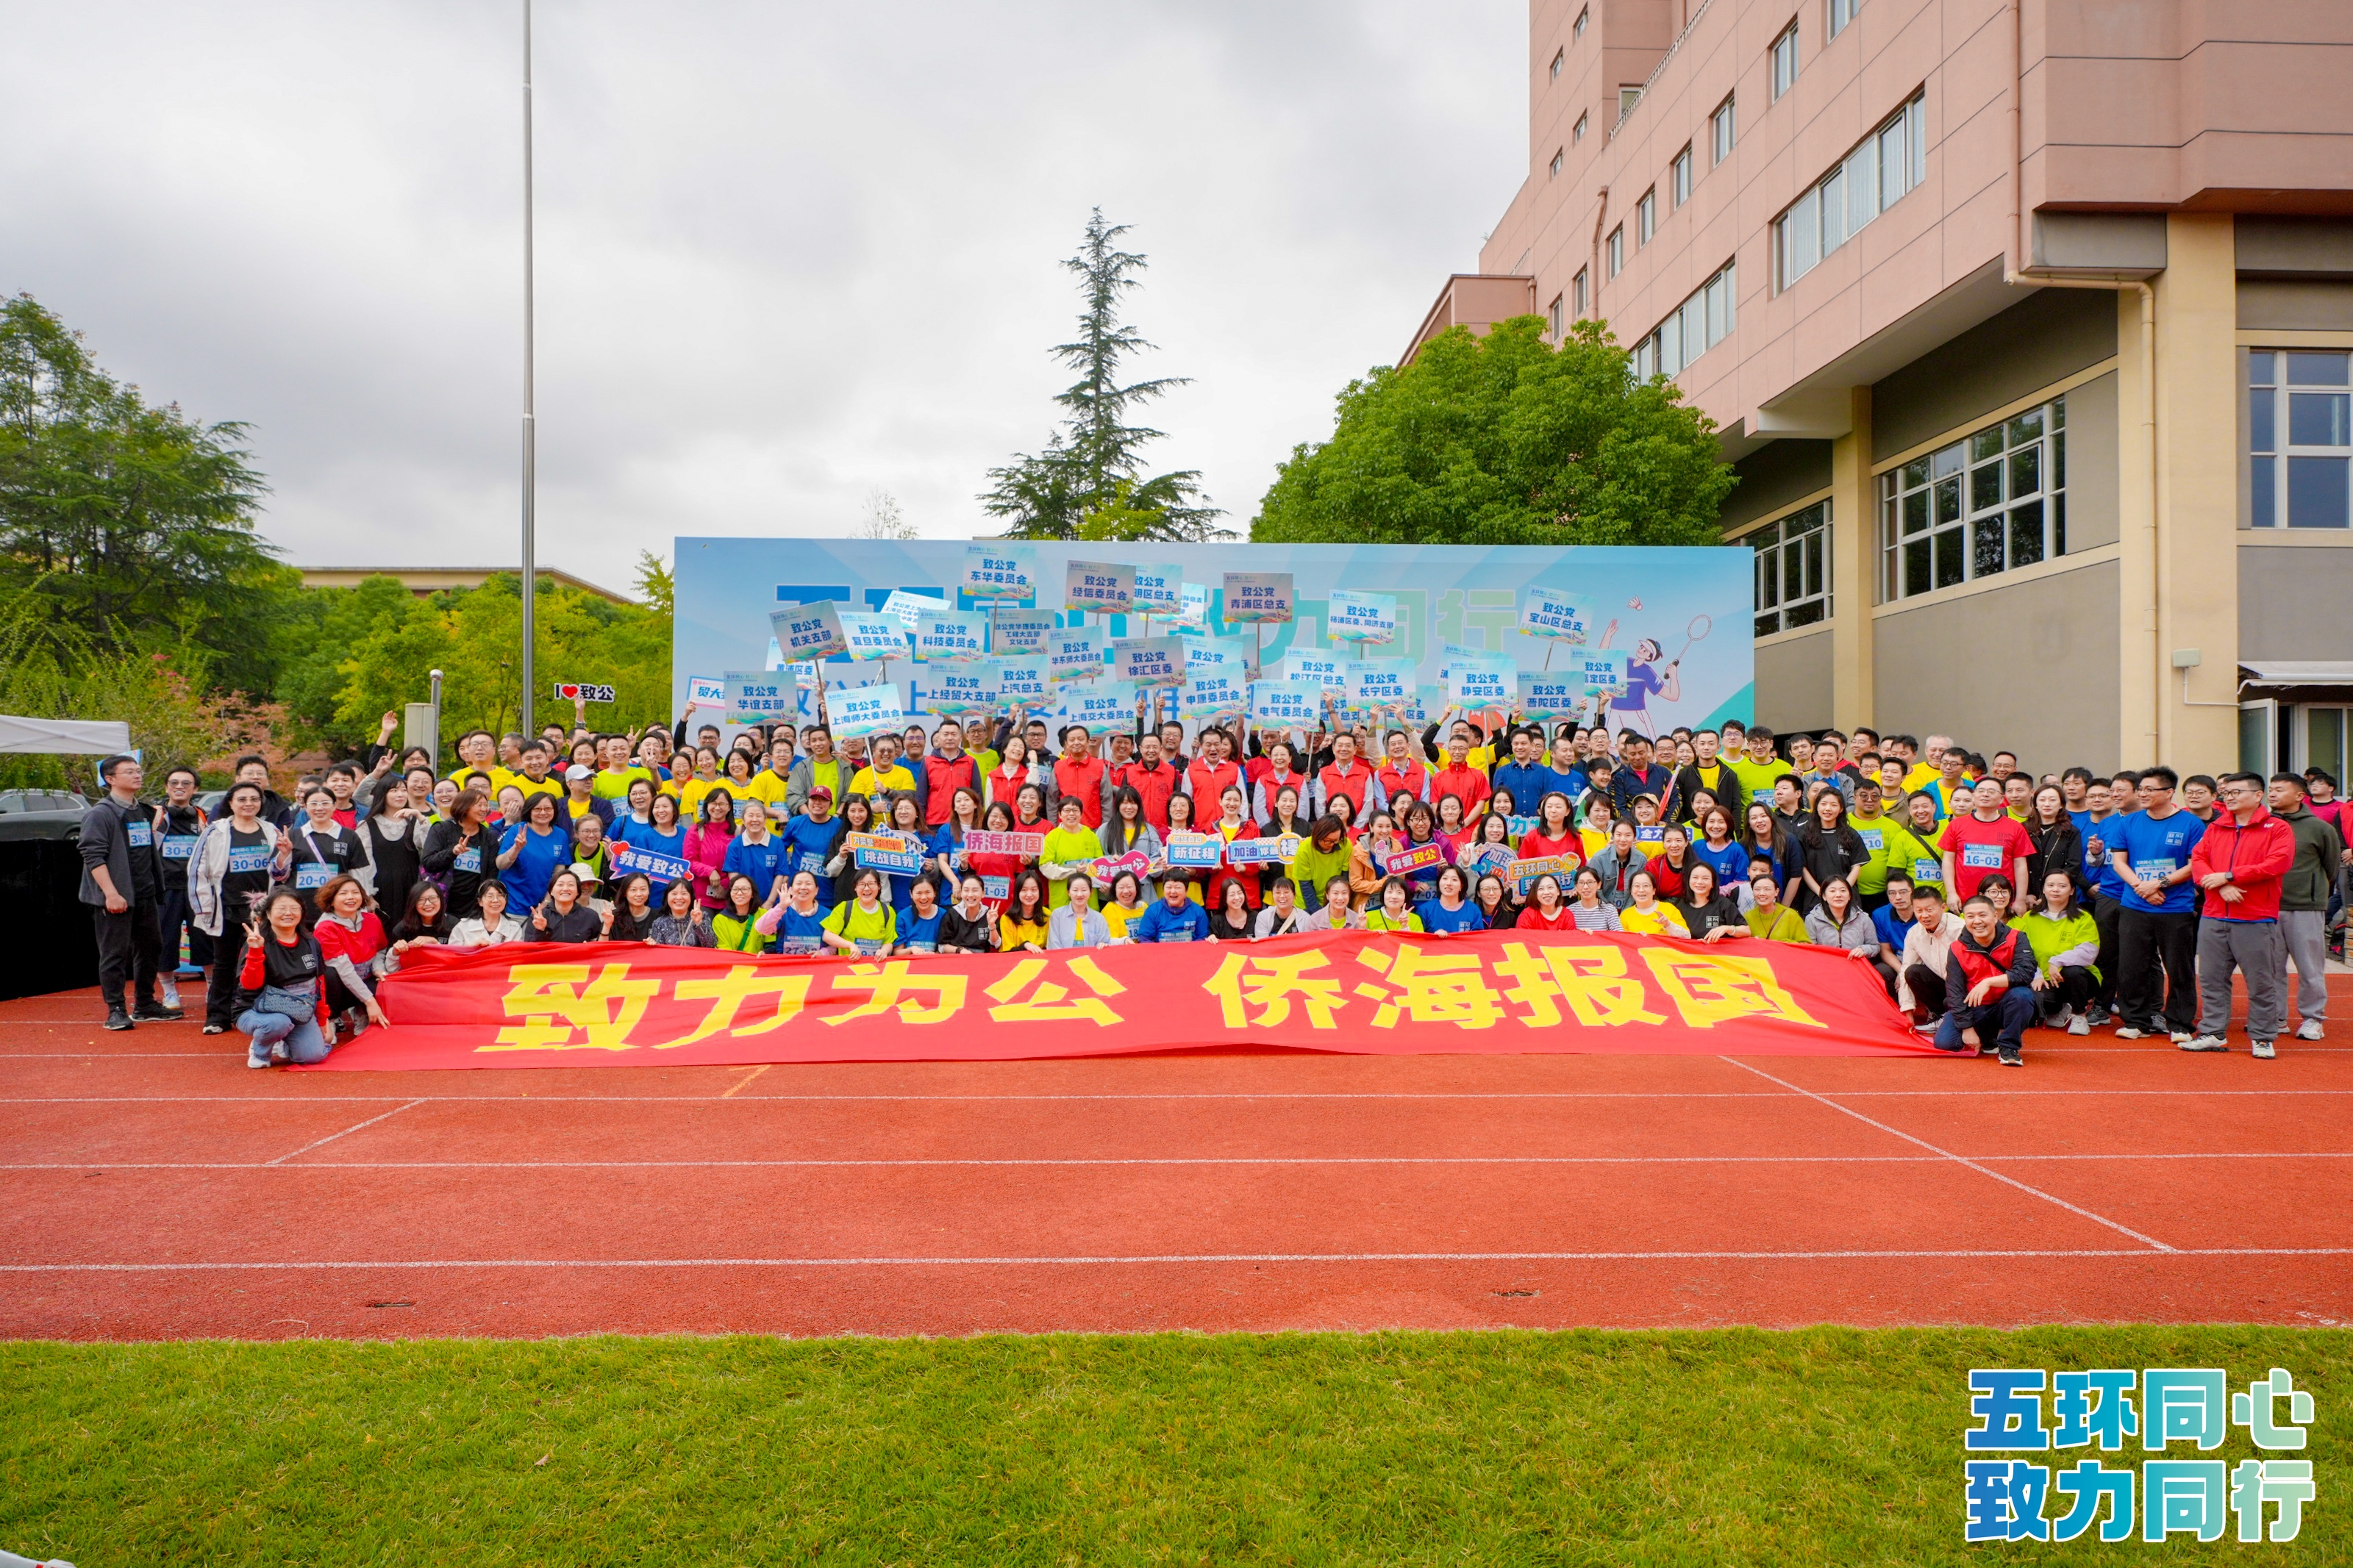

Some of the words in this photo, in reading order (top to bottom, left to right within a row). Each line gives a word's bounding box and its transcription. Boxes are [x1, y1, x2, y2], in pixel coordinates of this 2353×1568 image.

[982, 559, 1016, 571] 致公党
[971, 571, 1026, 584] 东华委员会
[1085, 576, 1117, 587] 致公党
[1072, 587, 1127, 601] 经信委员会
[1134, 589, 1174, 601] 明区总支
[1242, 587, 1274, 597] 致公党
[1231, 599, 1285, 610] 青浦区总支
[1543, 602, 1575, 617] 致公党
[1346, 605, 1379, 618] 致公党
[791, 618, 823, 634] 致公党
[1529, 612, 1583, 632] 宝山区总支
[858, 625, 889, 634] 致公党
[935, 623, 967, 635] 致公党
[790, 631, 832, 648] 机关支部
[852, 637, 902, 646] 复旦委员会
[923, 637, 977, 648] 科技委员会
[1063, 642, 1089, 654] 致公党
[1051, 652, 1101, 665] 华东师大委员会
[1132, 651, 1165, 663] 致公党
[1191, 650, 1224, 664] 致公党
[1129, 663, 1173, 676] 徐汇区委
[1302, 662, 1335, 673] 致公党
[1585, 662, 1612, 672] 致公党
[1004, 670, 1037, 681] 致公党
[1364, 673, 1397, 684] 致公党
[1466, 673, 1499, 684] 致公党
[946, 676, 979, 688] 致公党
[1195, 679, 1228, 692] 致公党
[556, 684, 560, 698] I
[580, 684, 613, 701] 致公
[743, 686, 778, 697] 致公党
[999, 683, 1043, 694] 上汽总支
[1359, 686, 1403, 698] 长宁区委
[1461, 686, 1504, 696] 静安区委
[1532, 685, 1566, 695] 致公党
[928, 689, 996, 702] 上经贸大支部
[1186, 690, 1240, 705] 申康委员会
[1271, 694, 1303, 705] 致公党
[738, 699, 785, 710] 华谊支部
[846, 700, 882, 712] 致公党
[1084, 698, 1118, 710] 致公党
[1527, 698, 1571, 708] 普陀区委
[832, 709, 900, 726] 上海师大委员会
[1069, 709, 1134, 723] 上海交大委员会
[1260, 706, 1313, 717] 电气委员会
[130, 834, 151, 844] 30-1
[965, 831, 1043, 853] 侨海报国
[165, 847, 193, 856] 30-0
[1174, 846, 1215, 860] 新征程
[232, 859, 268, 870] 30-06
[454, 858, 481, 870] 0-07
[619, 851, 685, 878] 我爱致公
[864, 851, 914, 868] 挑战自我
[1390, 848, 1436, 871] 我爱致公
[1965, 855, 1999, 867] 16-03
[1513, 859, 1561, 876] 五环同心
[1917, 870, 1941, 879] 14-0
[299, 876, 326, 887] 20-0
[985, 887, 1007, 897] 1-03
[473, 956, 1127, 1052] 致力为公
[1202, 942, 1829, 1029] 侨海报国
